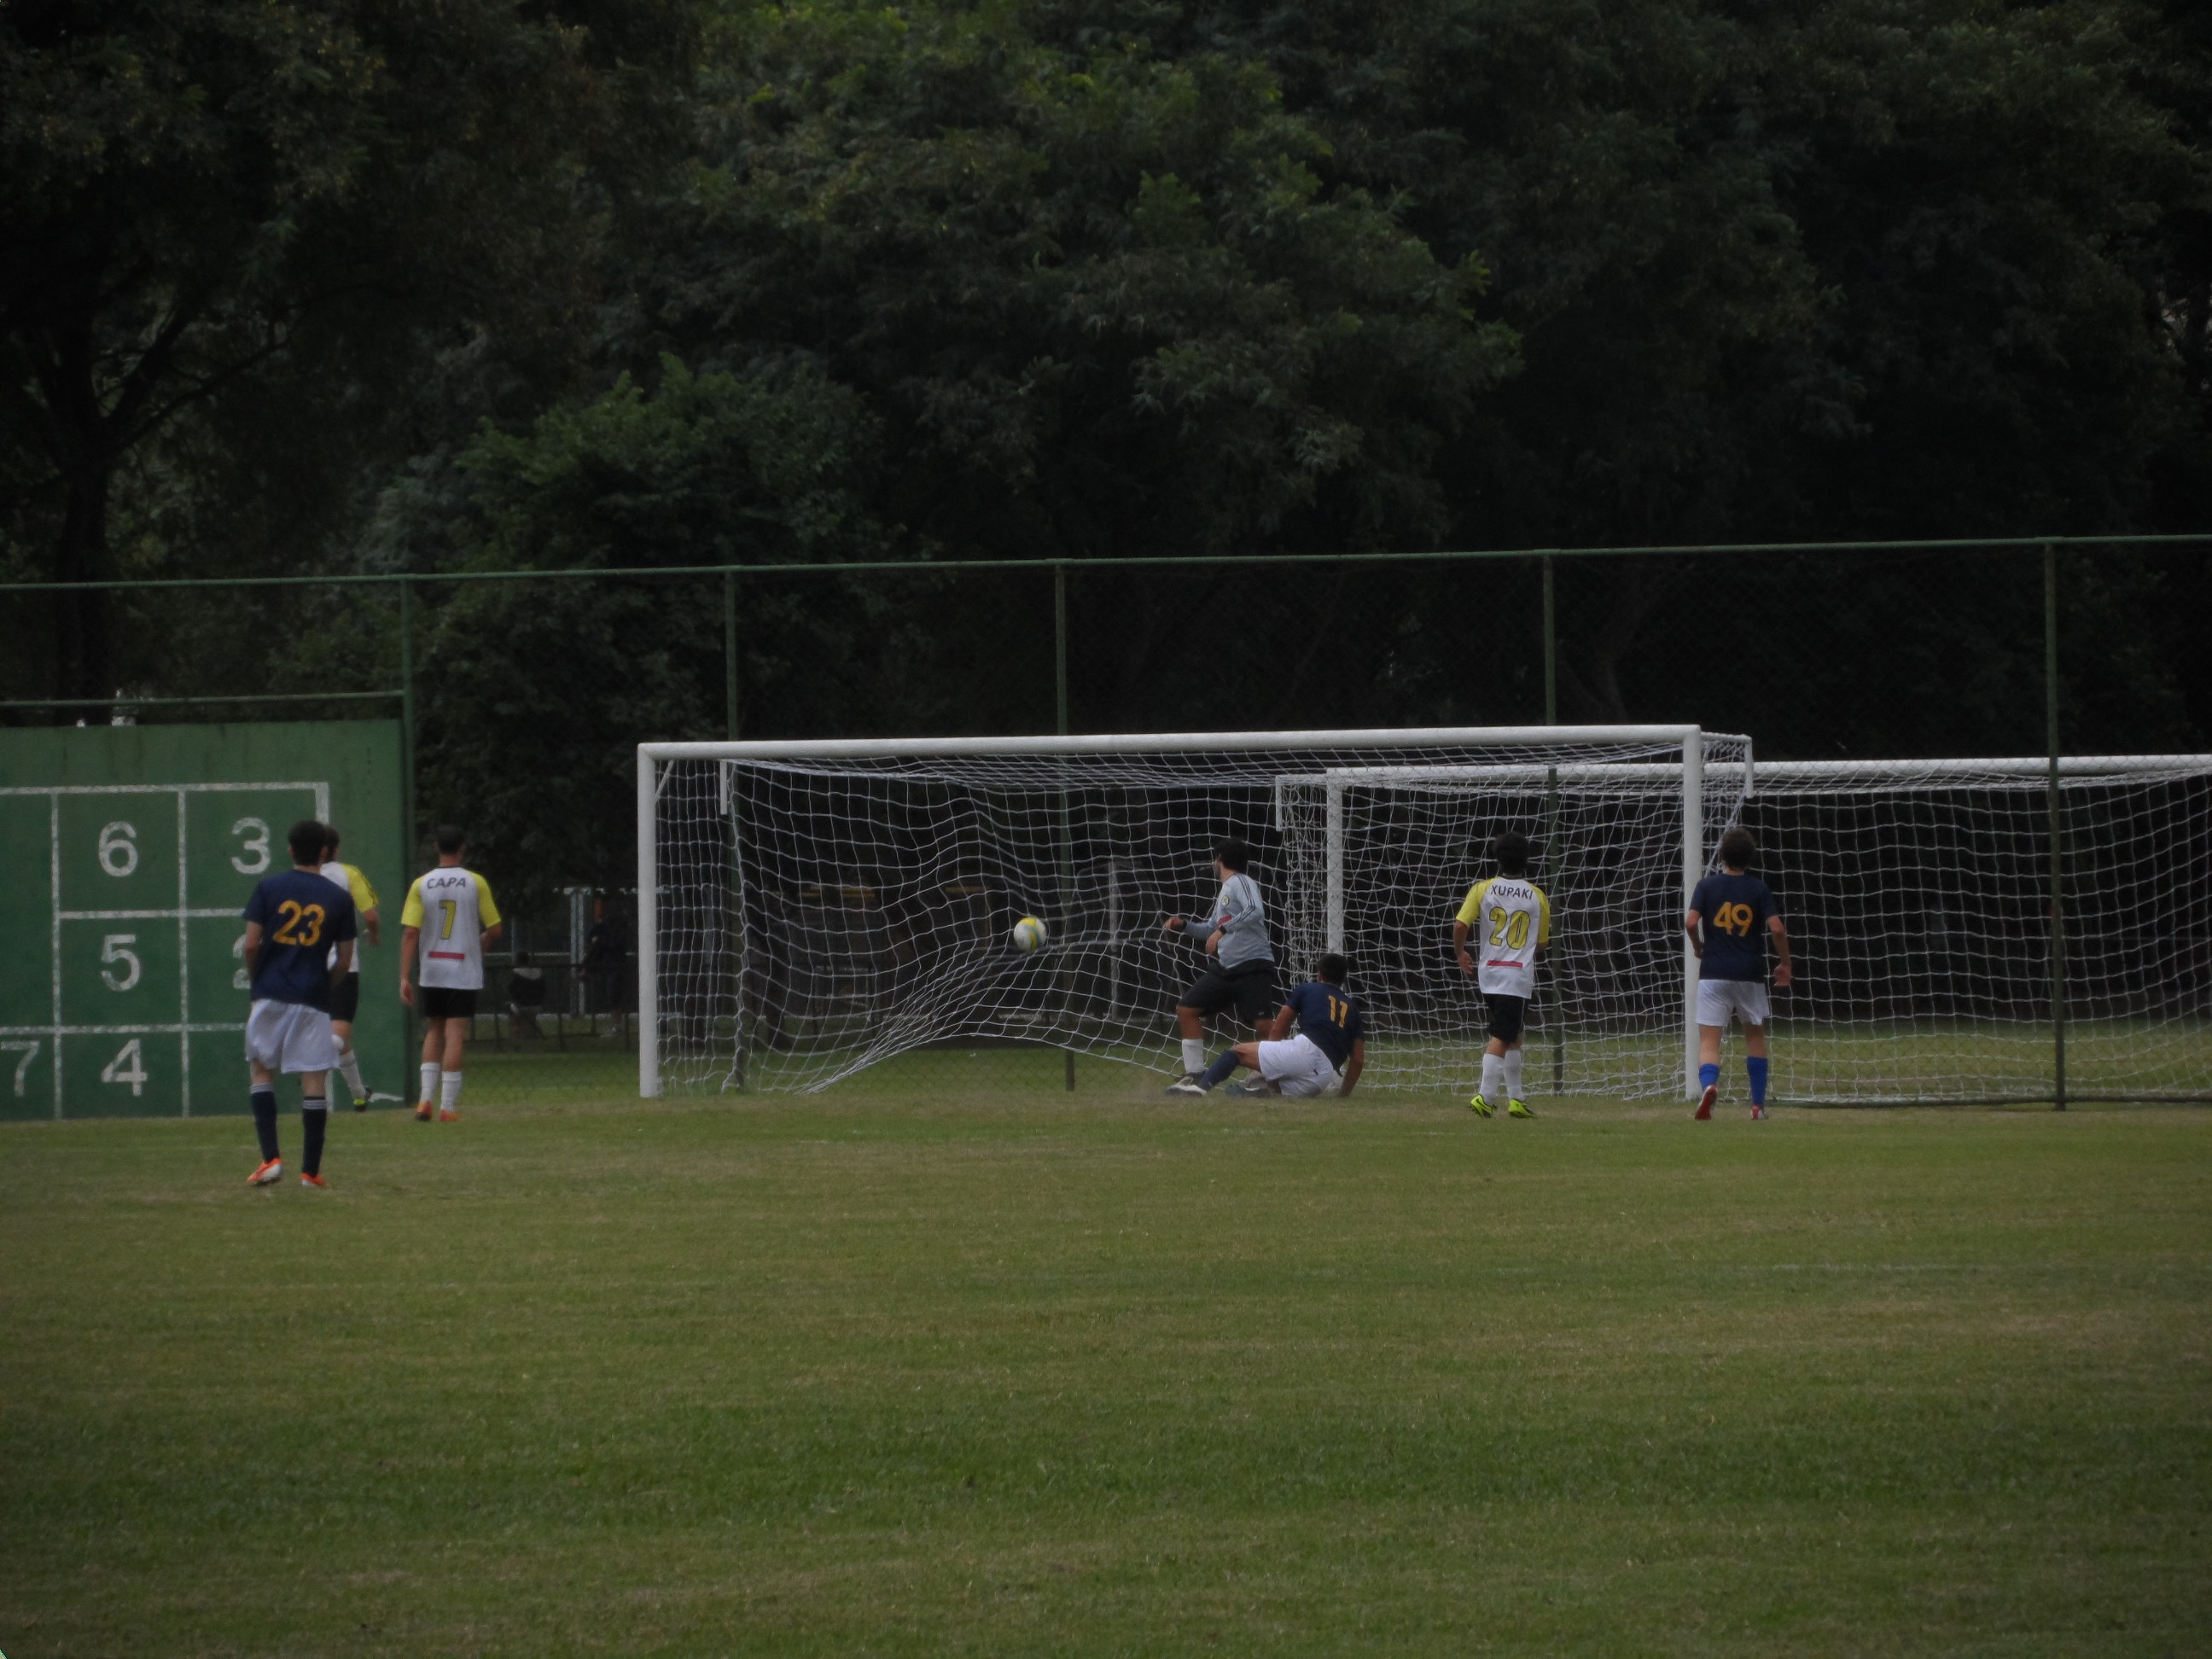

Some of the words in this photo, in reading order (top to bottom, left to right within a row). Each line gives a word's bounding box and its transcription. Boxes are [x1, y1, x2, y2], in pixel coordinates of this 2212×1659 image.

[98, 821, 137, 876] 6
[231, 817, 271, 874] 3
[427, 876, 466, 889] CAPA
[1490, 884, 1534, 899] XUPAKI
[273, 899, 326, 946] 23
[439, 899, 457, 939] 7
[1489, 906, 1530, 950] 20
[1713, 901, 1754, 937] 49
[100, 934, 141, 992] 5
[1328, 995, 1348, 1028] 11
[0, 1040, 40, 1097] 7
[101, 1039, 148, 1097] 4
